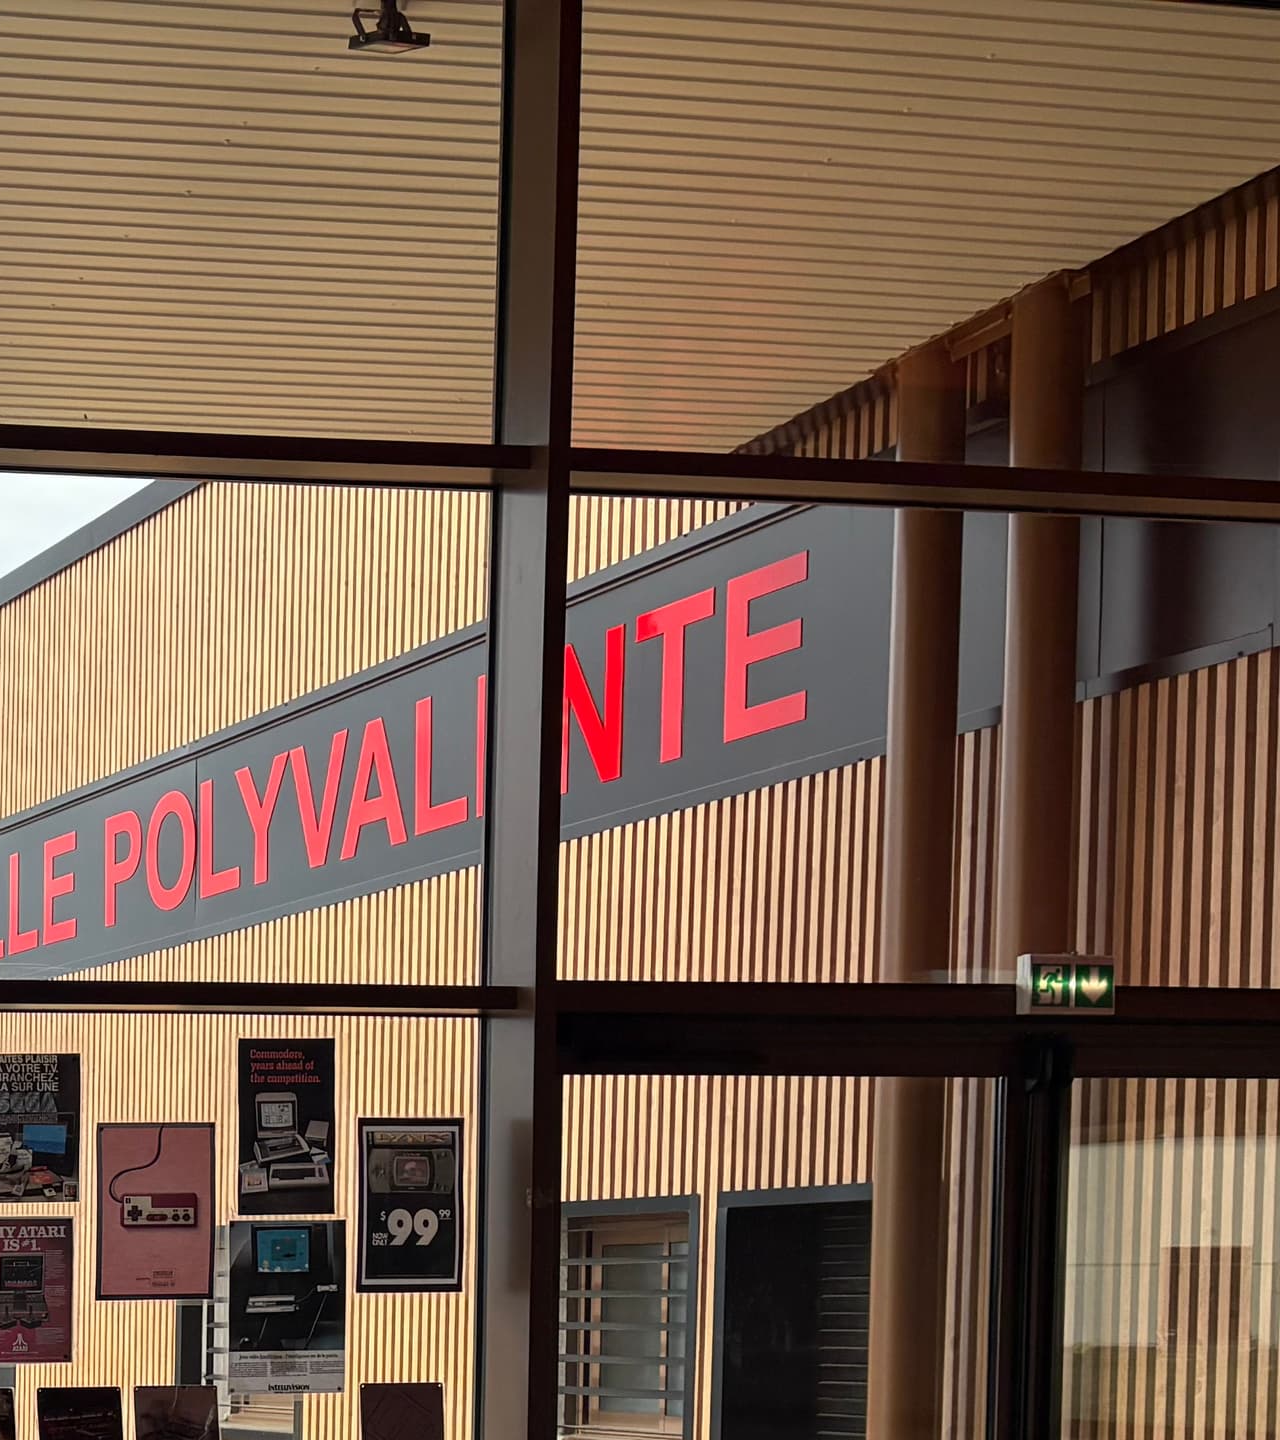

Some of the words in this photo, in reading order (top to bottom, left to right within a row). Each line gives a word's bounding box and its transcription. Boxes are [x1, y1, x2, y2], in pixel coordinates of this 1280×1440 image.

[104, 549, 811, 928] POLYVALNTE
[25, 1055, 58, 1064] PLAISIR
[250, 1049, 305, 1060] Commodore,
[6, 1063, 40, 1073] VOTRE
[43, 1064, 59, 1073] T.V.
[251, 1062, 274, 1072] years
[276, 1060, 303, 1071] ahead
[305, 1060, 314, 1071] of
[251, 1073, 265, 1084] the
[267, 1073, 321, 1086] competition.
[11, 1082, 33, 1092] SUR
[36, 1082, 59, 1092] UNE
[18, 1226, 66, 1239] ATARI
[380, 1210, 386, 1222] $
[387, 1208, 439, 1246] 99
[439, 1209, 451, 1218] 99
[372, 1232, 388, 1240] NOW
[3, 1239, 20, 1251] IS
[268, 1384, 310, 1392] INTELLIVISION
